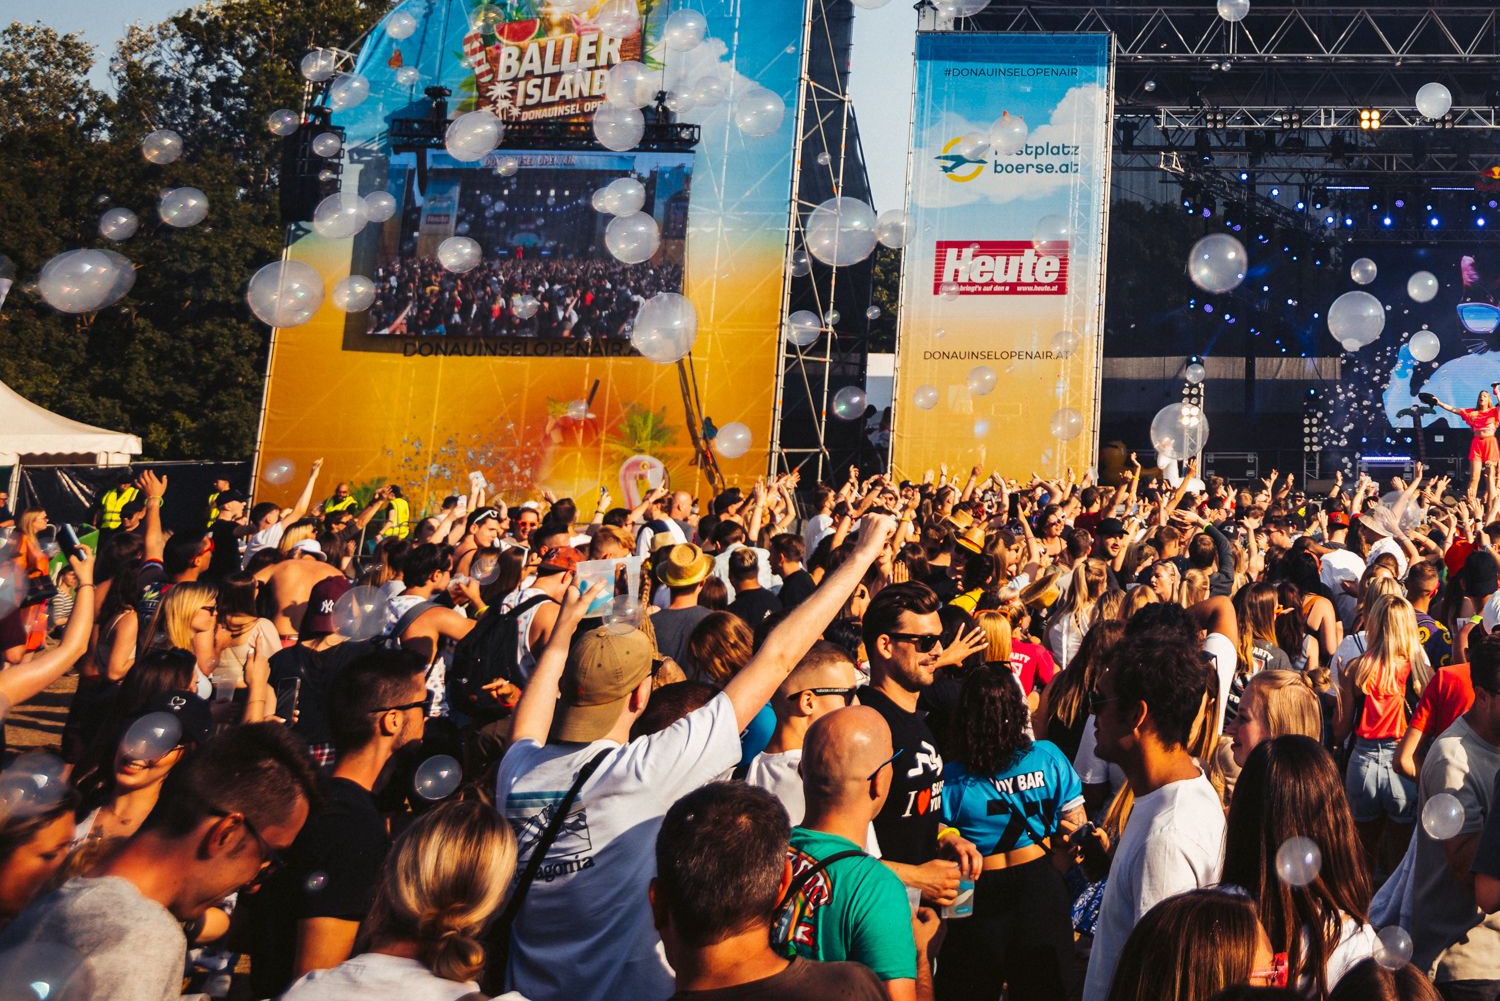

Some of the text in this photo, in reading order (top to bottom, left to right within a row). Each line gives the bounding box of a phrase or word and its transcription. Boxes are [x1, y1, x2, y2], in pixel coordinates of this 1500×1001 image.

[497, 33, 623, 82] BALLER
[944, 67, 1079, 77] #DONAUINSELOPENAIR
[517, 69, 610, 106] ISLAND
[521, 100, 608, 121] DONAUINSEL OPE
[994, 142, 1079, 159] stplatz
[994, 160, 1079, 174] boerse.at
[943, 247, 1061, 283] Heute
[1016, 284, 1058, 292] www.heute.at
[403, 340, 644, 357] DONAUINSELOPENAIR.A
[923, 350, 1070, 360] DONAUINSELOPENAIR.AT
[1009, 652, 1031, 663] ARTY
[1252, 647, 1274, 661] ARTY
[991, 770, 1045, 795] DY BAR
[521, 854, 595, 884] agonia
